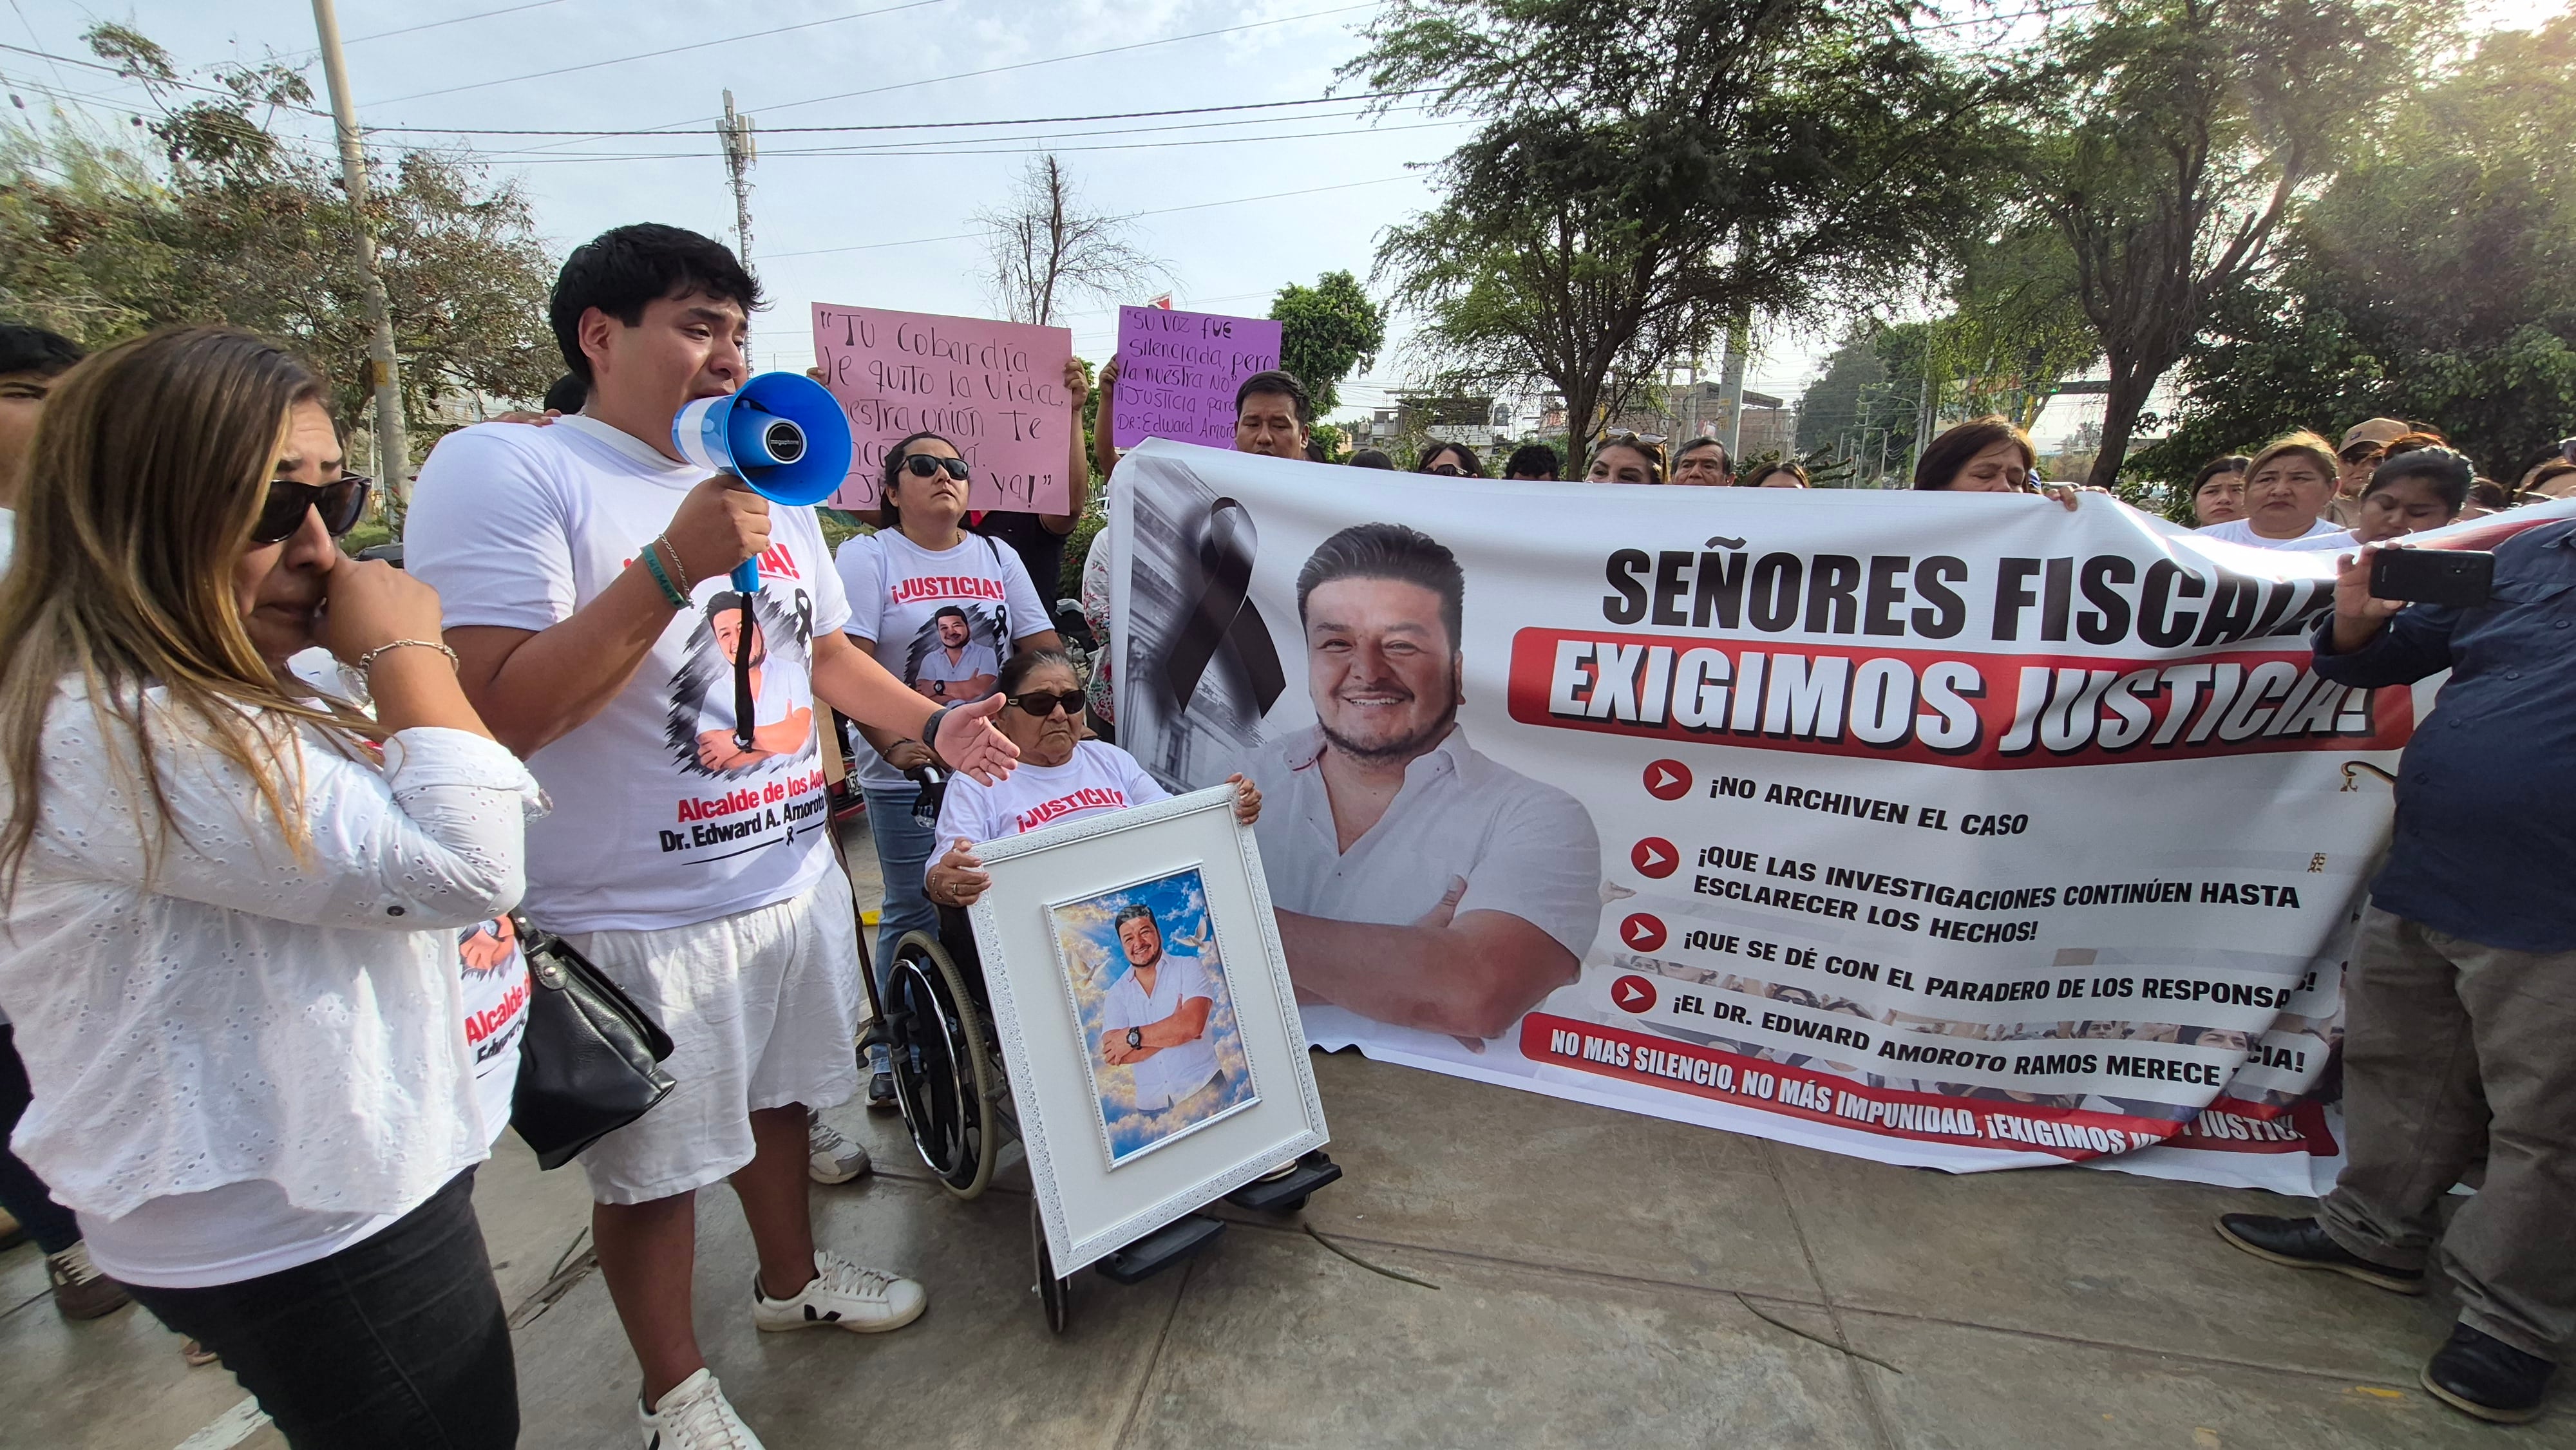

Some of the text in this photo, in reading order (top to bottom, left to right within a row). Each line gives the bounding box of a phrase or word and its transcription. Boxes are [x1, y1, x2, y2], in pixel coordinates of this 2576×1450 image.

[949, 368, 970, 400] la
[1122, 359, 1137, 381] la
[891, 576, 1005, 604] ¡JUSTICIA!
[1603, 536, 2336, 647] SEÑORES FISCALE
[1548, 639, 1984, 752] EXIGIMOS
[659, 830, 691, 852] Dr.
[692, 812, 762, 847] Edward
[765, 808, 781, 830] A.
[783, 793, 824, 824] Amoroto
[677, 788, 760, 823] Alcalde
[763, 781, 784, 804] de
[787, 776, 808, 797] los
[1709, 776, 2029, 836] ¡NO ARCHIVEN EL CASO
[1694, 875, 2038, 944] ESCLARECER LOS HECHOS!
[1698, 846, 2300, 912] ¡QUE LAS INVESTIGACIONES CONTINÚEN HASTA
[1683, 929, 1740, 954] ¡QUE
[1747, 941, 1776, 961] SE
[1785, 947, 1817, 970] DÉ
[1825, 956, 1879, 981] CON
[1887, 968, 1915, 992] EL
[1924, 977, 2050, 1002] PARADERO
[2056, 978, 2085, 999] DE
[2091, 977, 2133, 997] LOS
[464, 986, 523, 1046] Alcalde
[1672, 994, 1704, 1015] ¡EL
[1713, 1003, 1752, 1026] DR.
[1761, 1012, 1870, 1050] EDWARD
[1877, 1040, 2007, 1073] AMOROTO
[2013, 1054, 2098, 1075] RAMOS
[2106, 1055, 2221, 1087] MERECE
[1550, 1028, 1580, 1057] NO
[1583, 1035, 1630, 1068] MAS
[1634, 1046, 1737, 1094] SILENCIO,
[1741, 1069, 1775, 1100] NO
[1778, 1080, 1833, 1113] MÁS
[1835, 1091, 1984, 1138] IMPUNIDAD,
[1986, 1113, 2126, 1155] ¡EXIGIMOS
